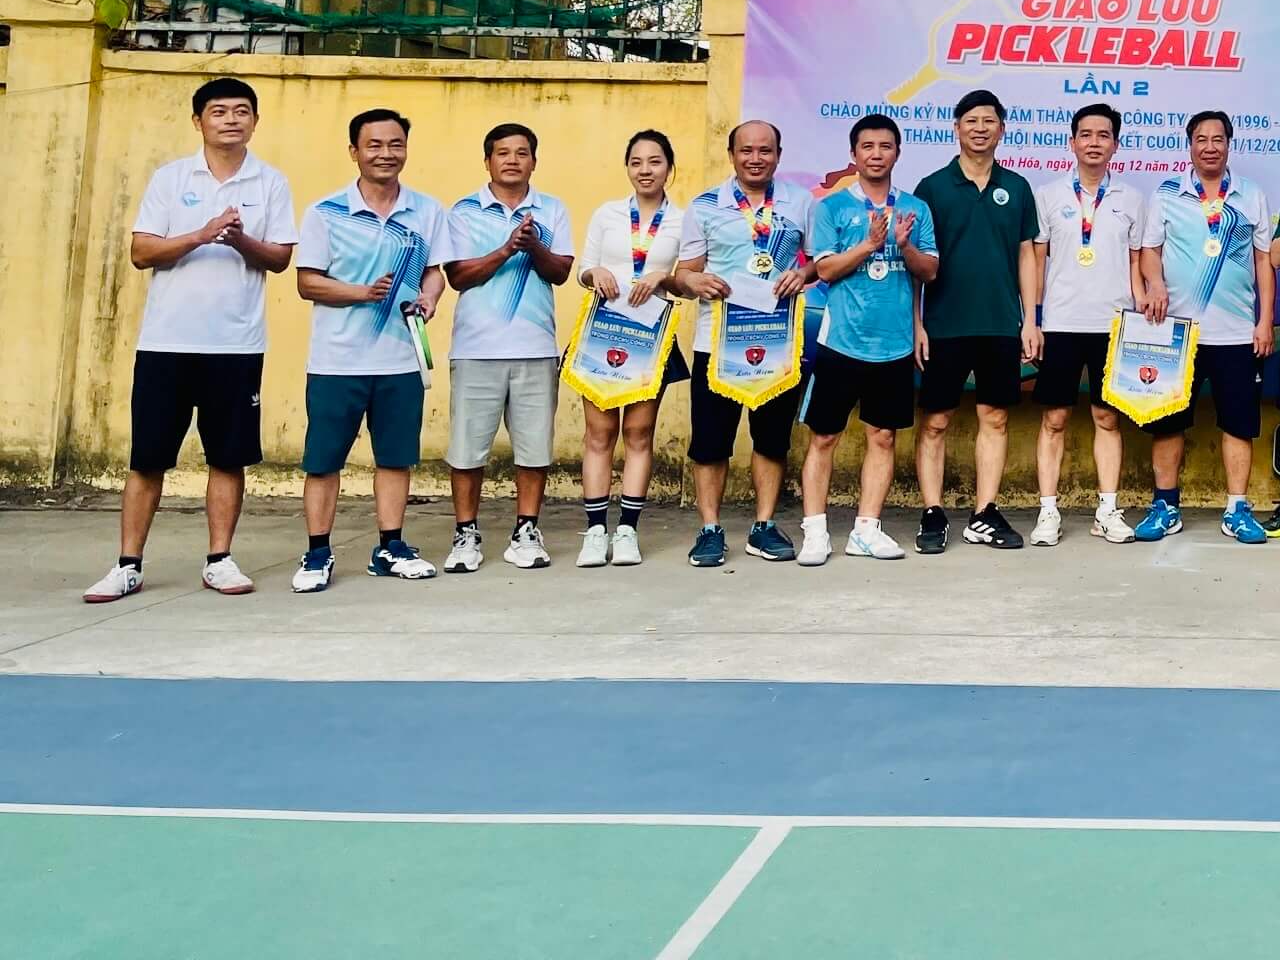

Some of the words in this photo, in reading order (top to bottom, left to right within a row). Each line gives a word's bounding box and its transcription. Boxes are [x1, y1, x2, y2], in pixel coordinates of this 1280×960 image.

[946, 23, 1241, 69] PICKLEBALL
[1064, 73, 1121, 95] LẦN
[1132, 82, 1150, 96] 2
[821, 101, 861, 117] CHÀO
[865, 102, 910, 119] MỪNG
[1036, 106, 1075, 123] THÀN
[1123, 109, 1163, 125] CÔNG
[1167, 113, 1186, 126] TY
[903, 126, 954, 143] THÀNH
[1003, 129, 1028, 149] HỘI
[1033, 132, 1068, 149] NGHỊ
[1146, 132, 1180, 149] CUỐI
[1046, 157, 1073, 172] ngày
[1129, 160, 1142, 171] 12
[1145, 160, 1169, 172] năm
